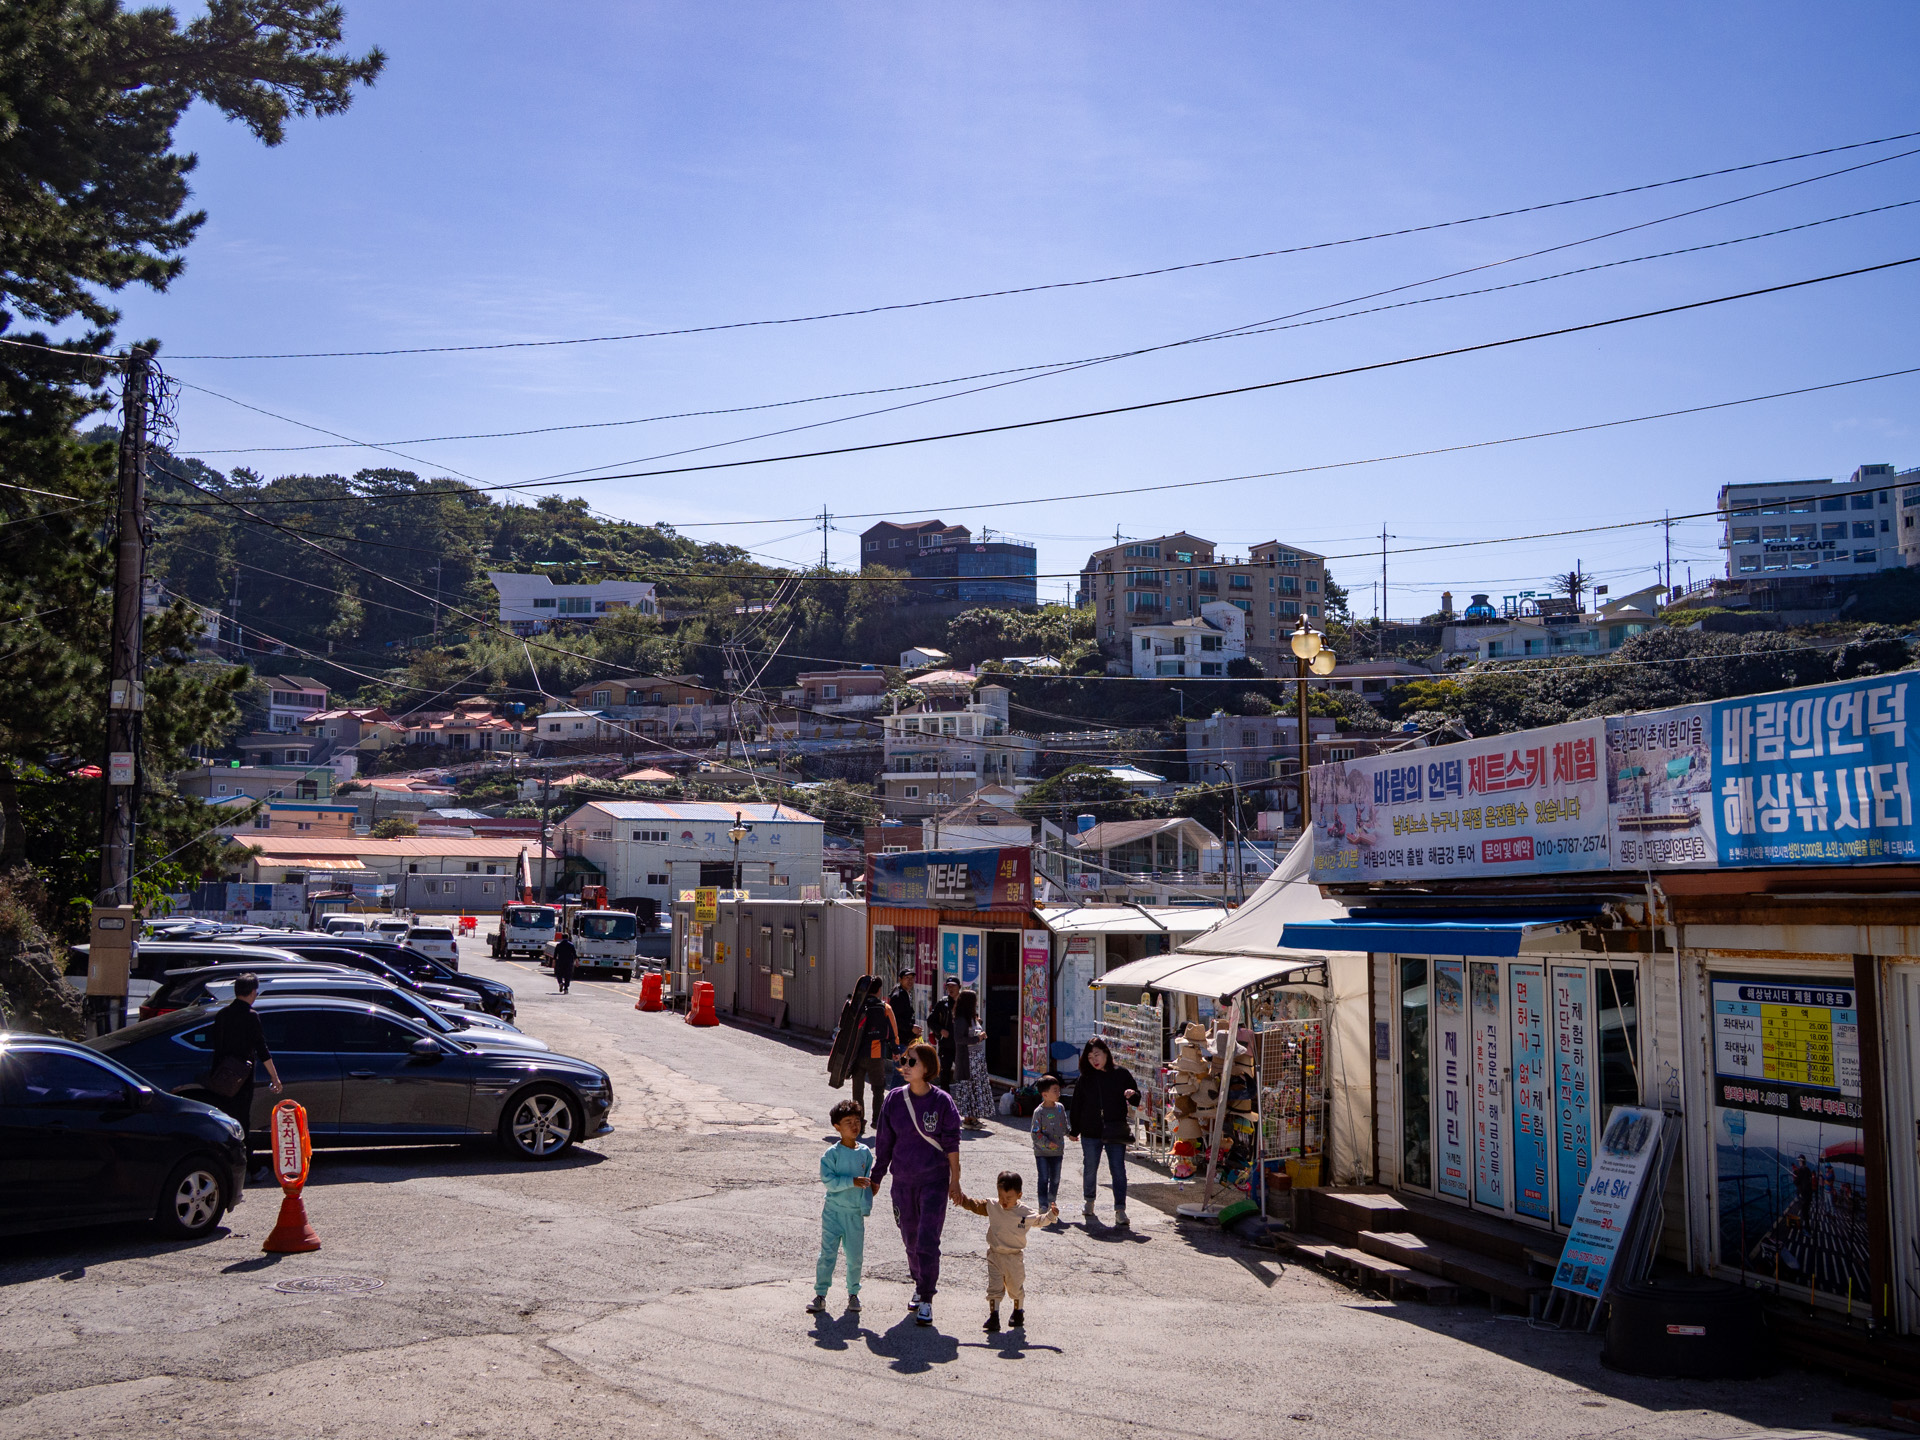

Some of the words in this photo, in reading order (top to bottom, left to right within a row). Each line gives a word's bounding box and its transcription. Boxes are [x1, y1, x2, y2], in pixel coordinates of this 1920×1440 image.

[1763, 543, 1805, 553] Terrace
[1808, 541, 1836, 550] CAFE
[1722, 684, 1908, 767] 바람의언덕
[1373, 765, 1424, 805] 바람의
[1428, 759, 1463, 798] 언덕
[1468, 746, 1548, 795] 제트스키
[1553, 737, 1598, 784] 체험
[1722, 762, 1913, 836] 해상낚시터
[1392, 810, 1428, 836] 남녀노소
[1430, 807, 1459, 832] 누구나
[1462, 804, 1482, 829] 직접
[1534, 797, 1580, 824] 있습니다
[1407, 848, 1424, 866] 출발
[1428, 846, 1455, 865] 해금강
[1457, 844, 1475, 864] 투어
[1513, 839, 1531, 857] 예약
[1620, 840, 1637, 863] 선명
[1869, 838, 1882, 855] 할인
[1337, 849, 1359, 868] 30분
[1747, 988, 1790, 1002] 해상낚시터
[1794, 992, 1812, 1003] 체험
[1817, 993, 1844, 1005] 이용료
[1724, 1019, 1754, 1031] 좌대낚시
[1724, 1041, 1755, 1055] 좌대낚시
[1733, 1056, 1748, 1066] 대절
[282, 1114, 297, 1170] 주차금지
[1575, 1124, 1588, 1205] 있습니
[1591, 1176, 1610, 1196] Jet
[1611, 1179, 1632, 1200] Ski
[1601, 1217, 1612, 1230] 30
[1567, 1249, 1607, 1266] 010-5787-2574
